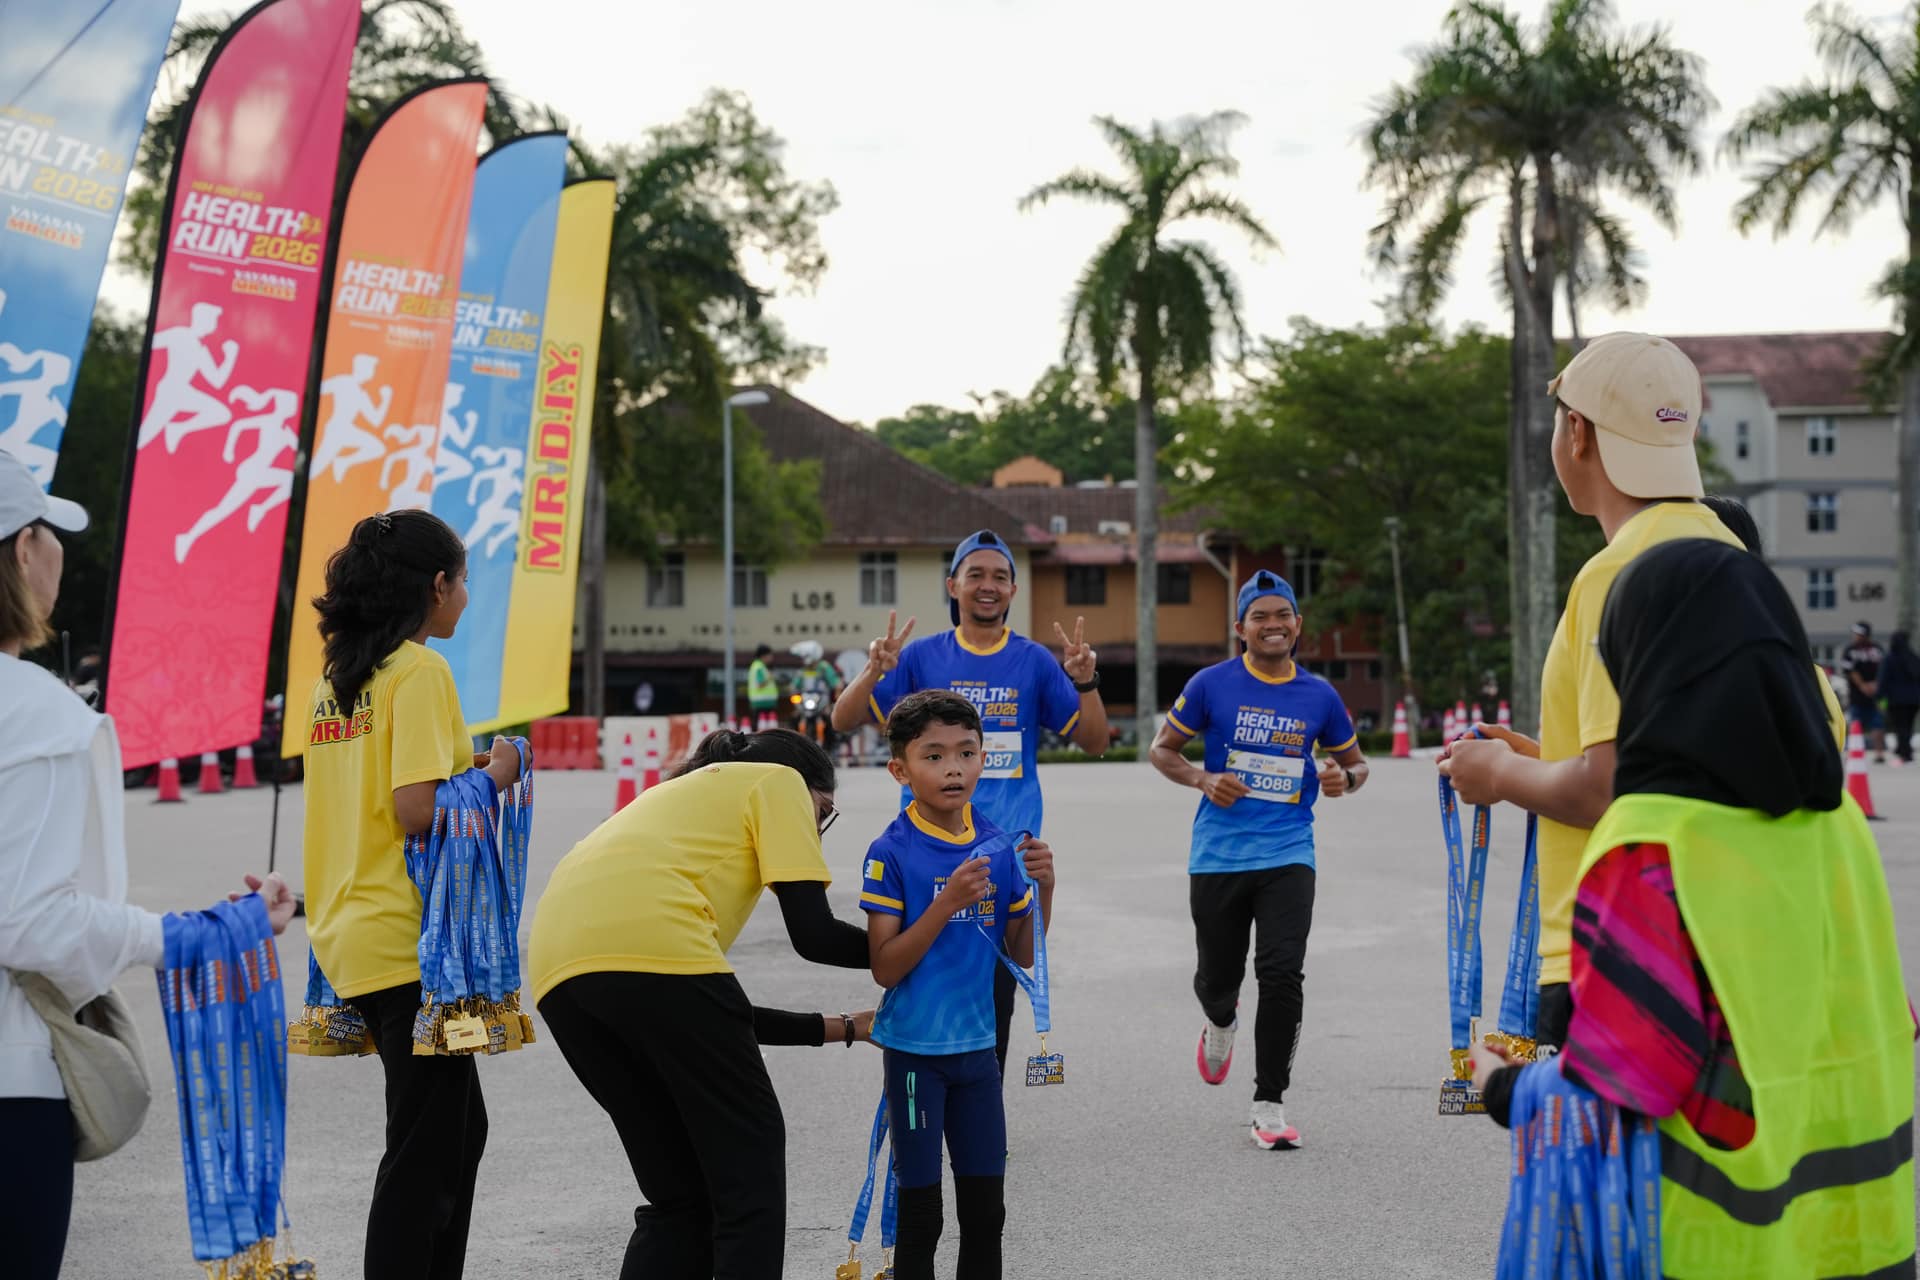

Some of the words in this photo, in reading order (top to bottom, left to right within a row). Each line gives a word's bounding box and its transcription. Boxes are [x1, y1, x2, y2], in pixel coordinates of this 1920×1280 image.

[0, 118, 105, 175] EALTH
[32, 166, 119, 211] 2026
[180, 191, 305, 237] HEALTH
[173, 220, 248, 259] RUN
[251, 234, 320, 266] 2026
[342, 259, 444, 297] HEALTH
[336, 285, 399, 316] RUN
[456, 300, 529, 329] EALTH
[485, 328, 538, 352] 2026
[985, 703, 1018, 716] 2026
[1235, 711, 1297, 732] HEALTH
[1234, 727, 1270, 744] RUN
[1271, 730, 1306, 746] 2026
[984, 753, 1013, 768] 087
[1251, 774, 1292, 791] 3088
[1028, 1067, 1056, 1076] HEALTH
[1028, 1075, 1044, 1084] RUN
[1440, 1103, 1463, 1112] RUN
